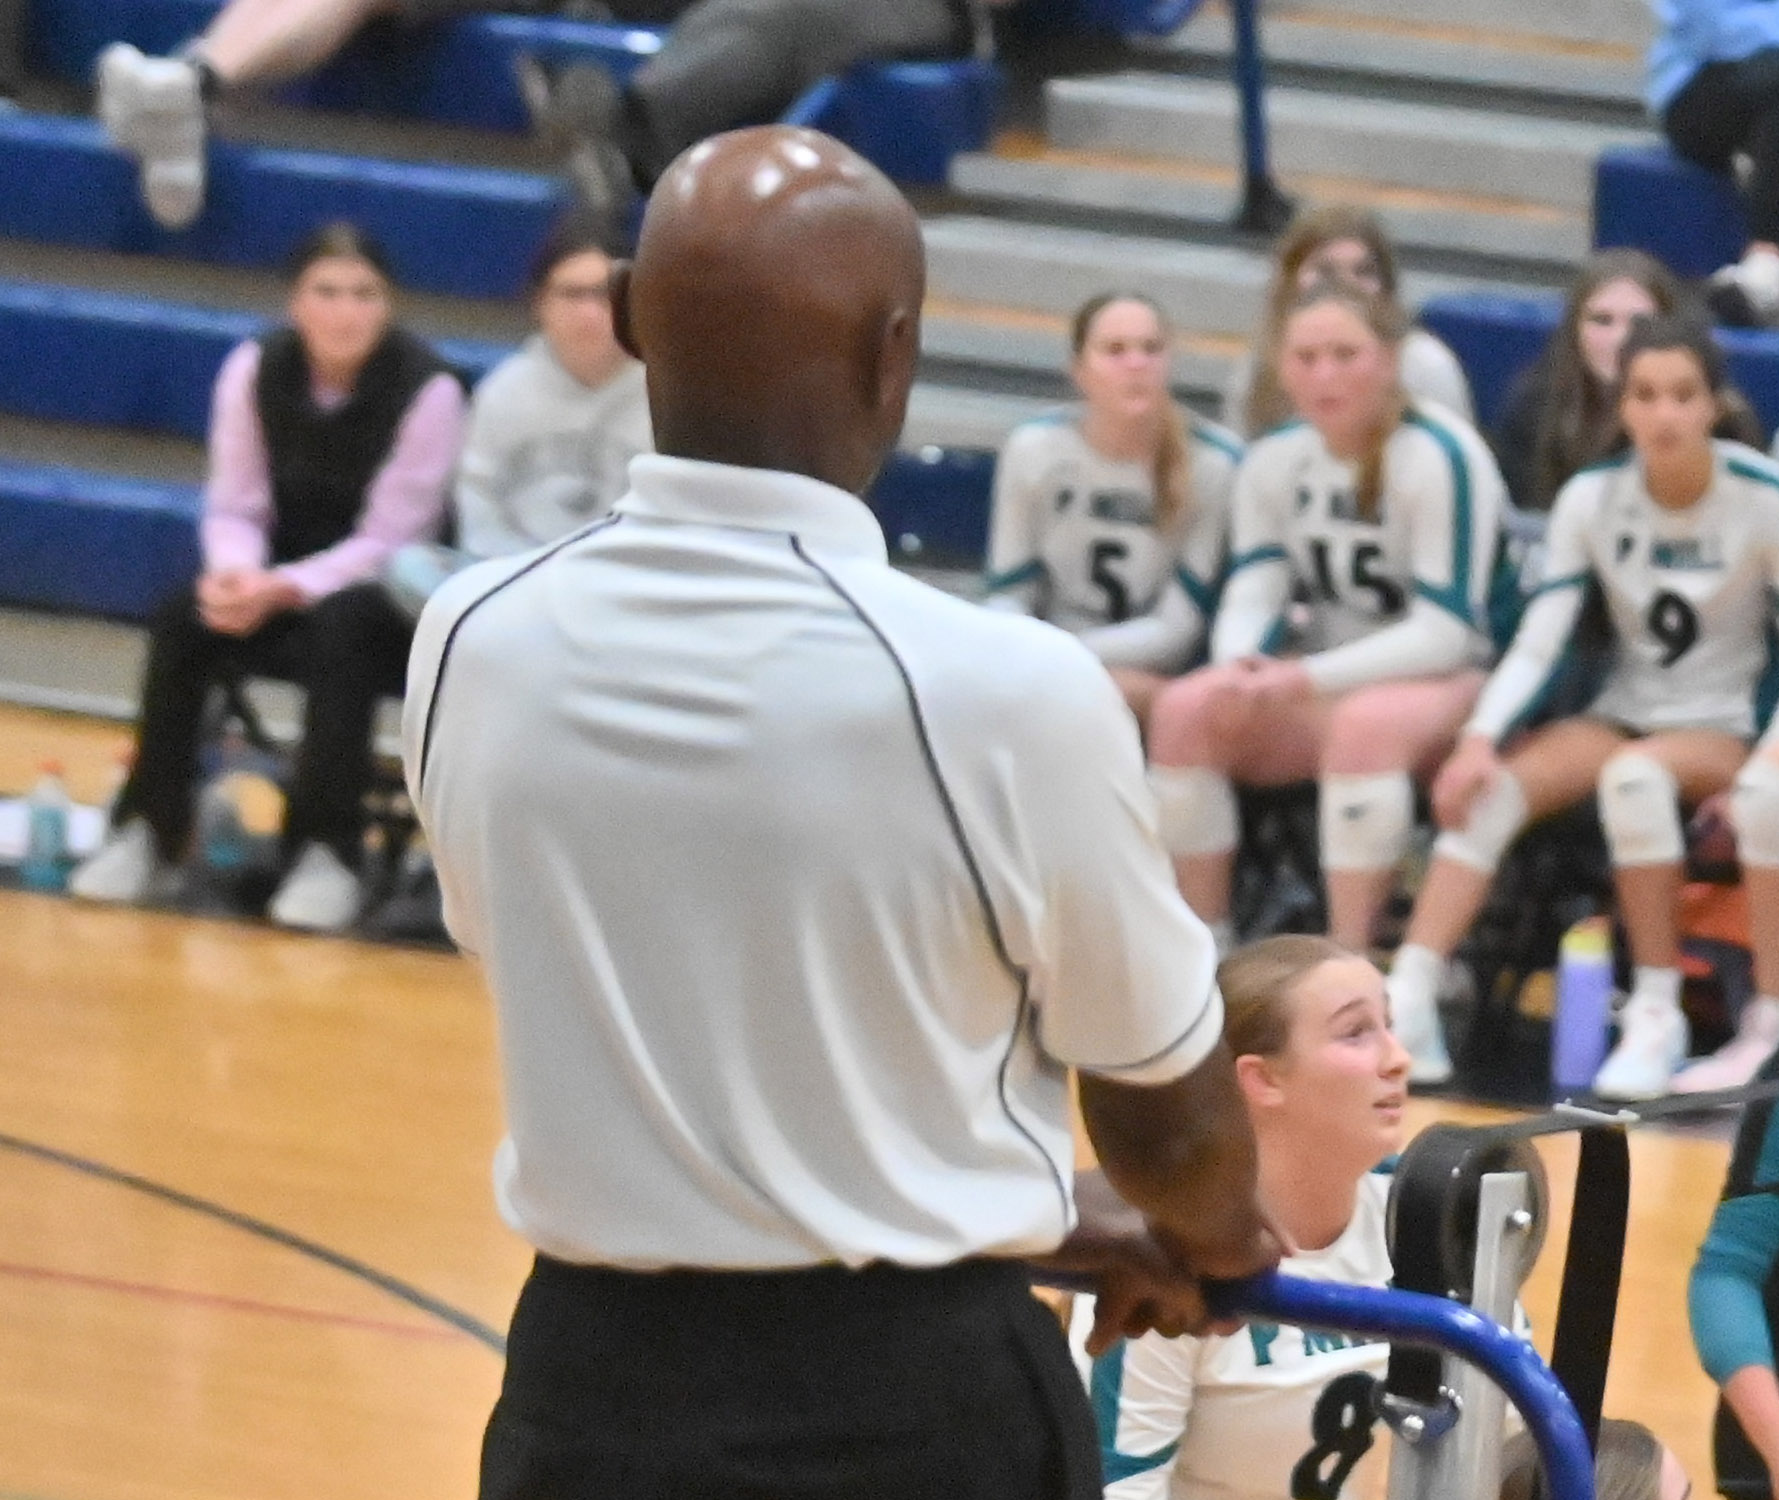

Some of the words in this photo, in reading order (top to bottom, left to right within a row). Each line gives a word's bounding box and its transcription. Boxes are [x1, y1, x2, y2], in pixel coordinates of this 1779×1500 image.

[1090, 537, 1131, 621] 5
[1304, 536, 1405, 616] 15
[1648, 586, 1700, 670] 9
